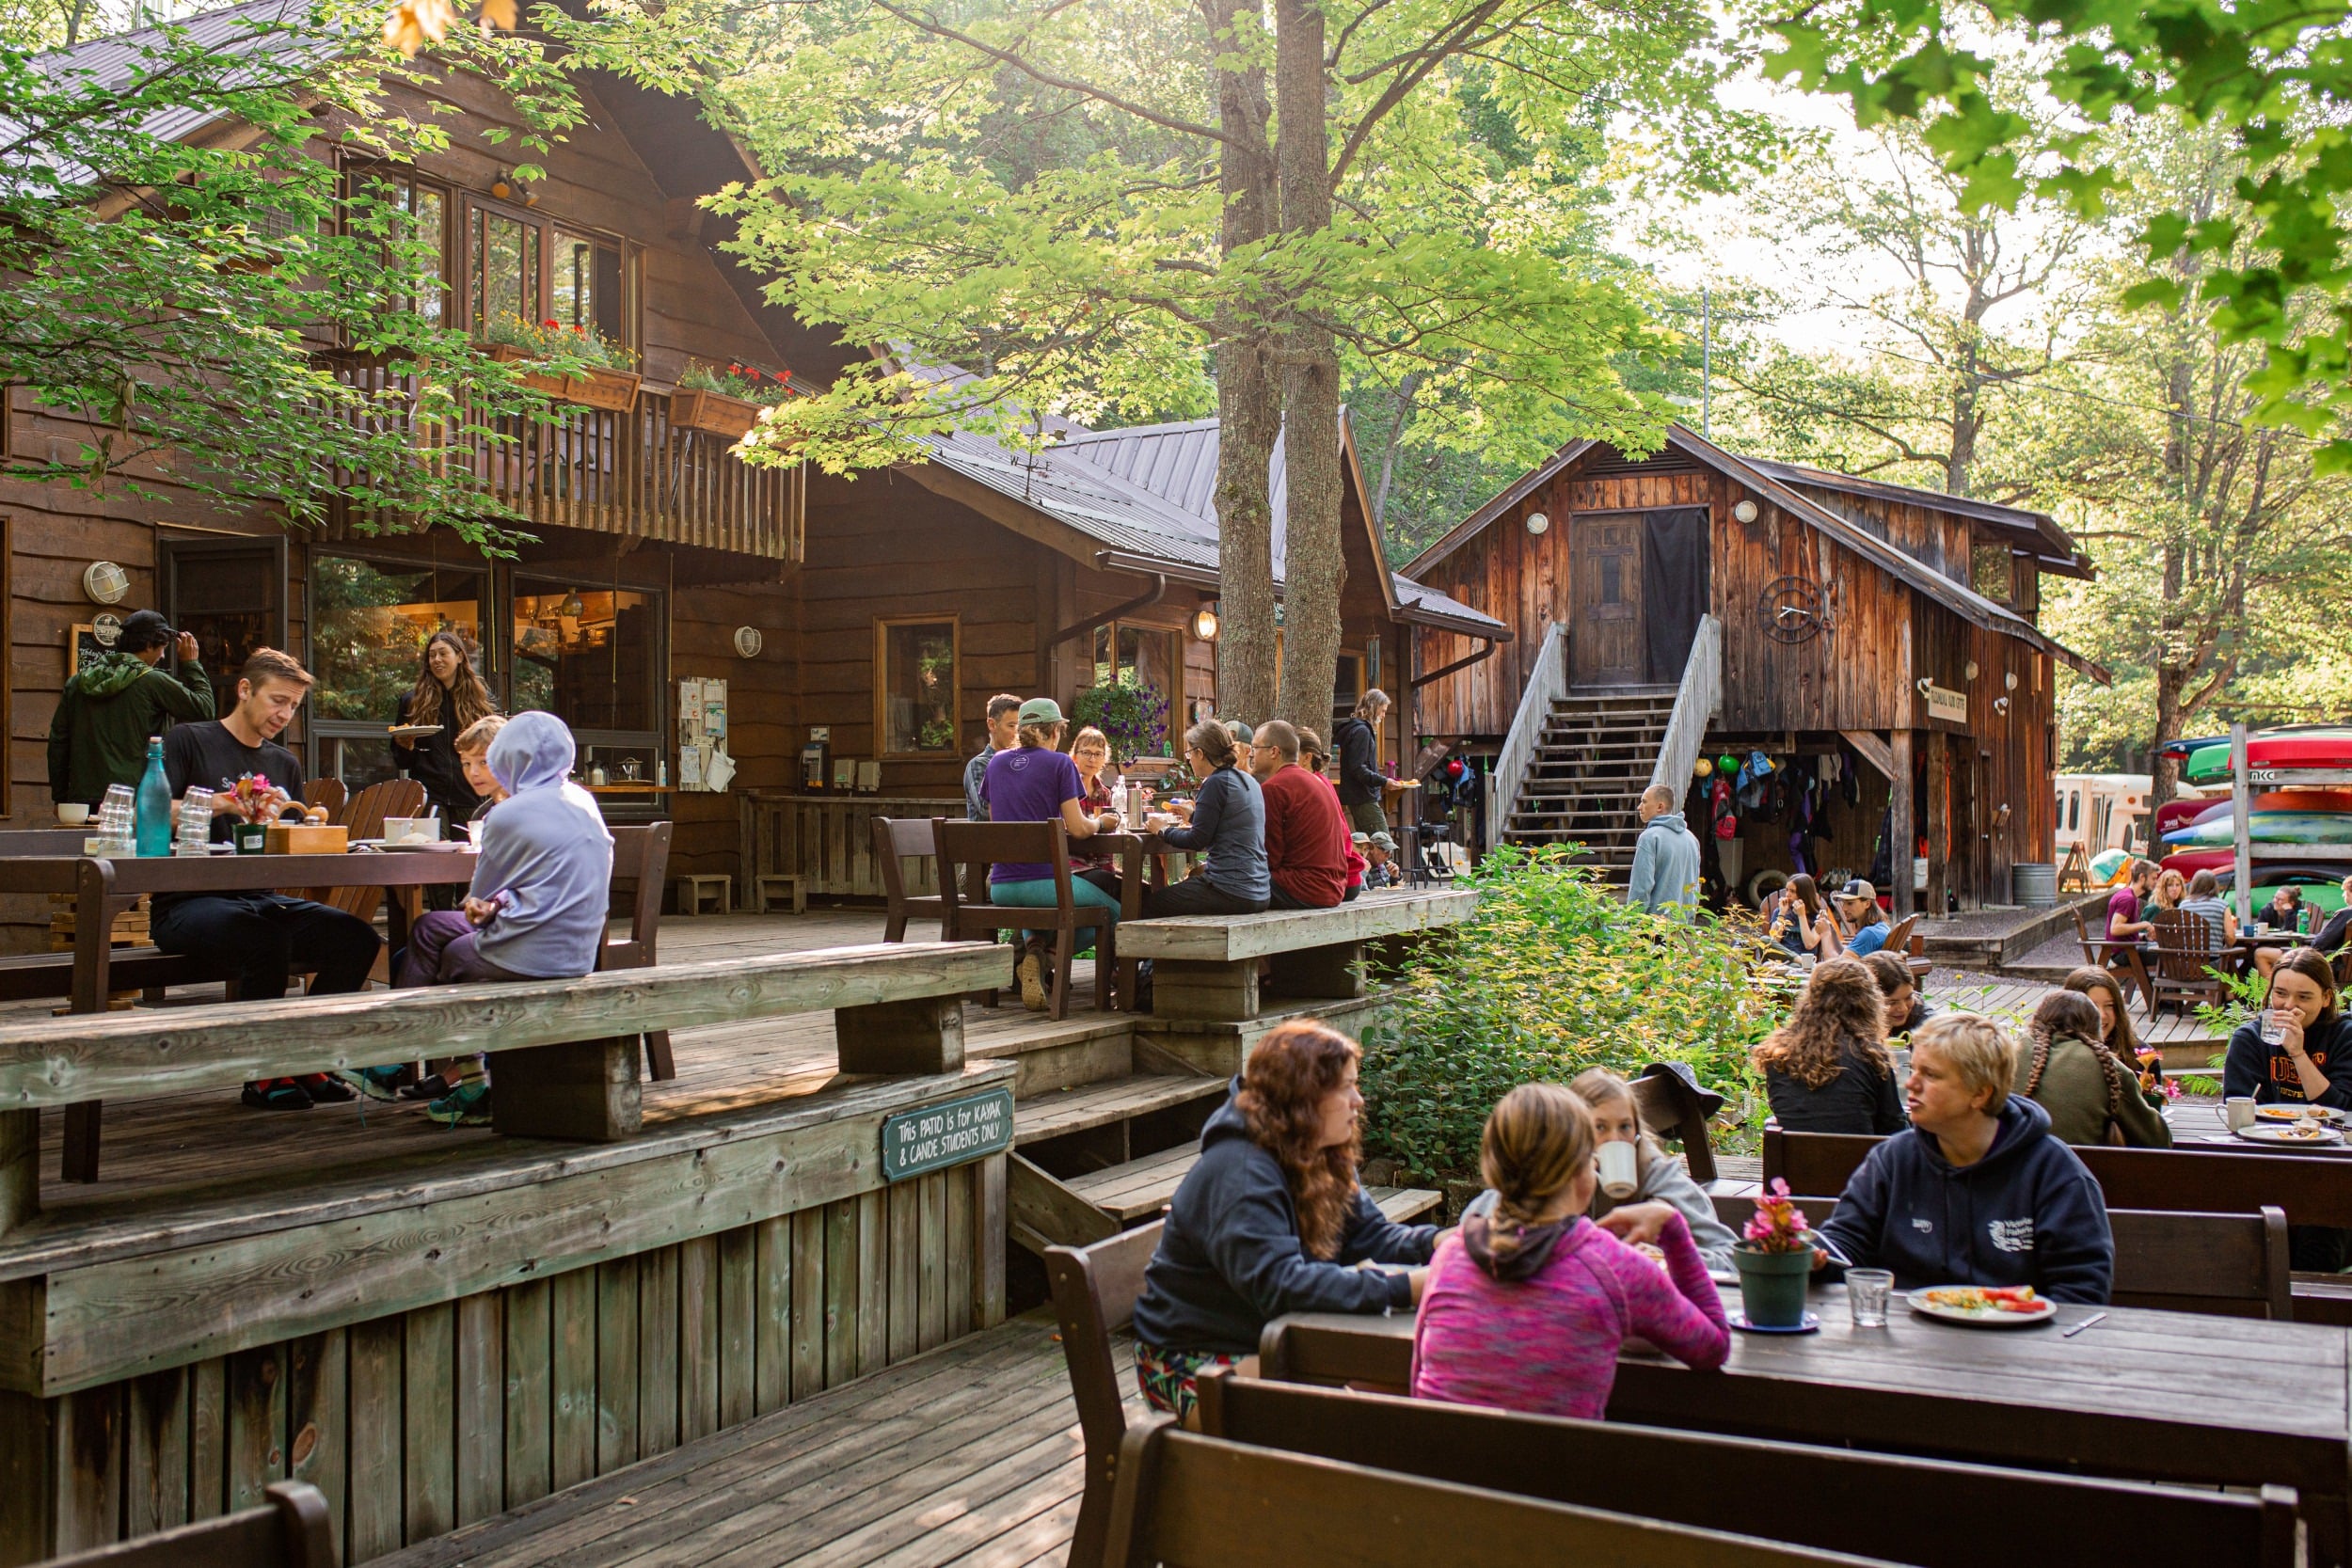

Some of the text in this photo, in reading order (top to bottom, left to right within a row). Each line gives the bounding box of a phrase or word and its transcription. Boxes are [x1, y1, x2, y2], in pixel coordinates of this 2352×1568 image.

[2249, 770, 2273, 780] MKC
[898, 1101, 1000, 1144] This PATIO is for KAYAK
[899, 1121, 1000, 1166] & CANOE STUDENTS ONLY
